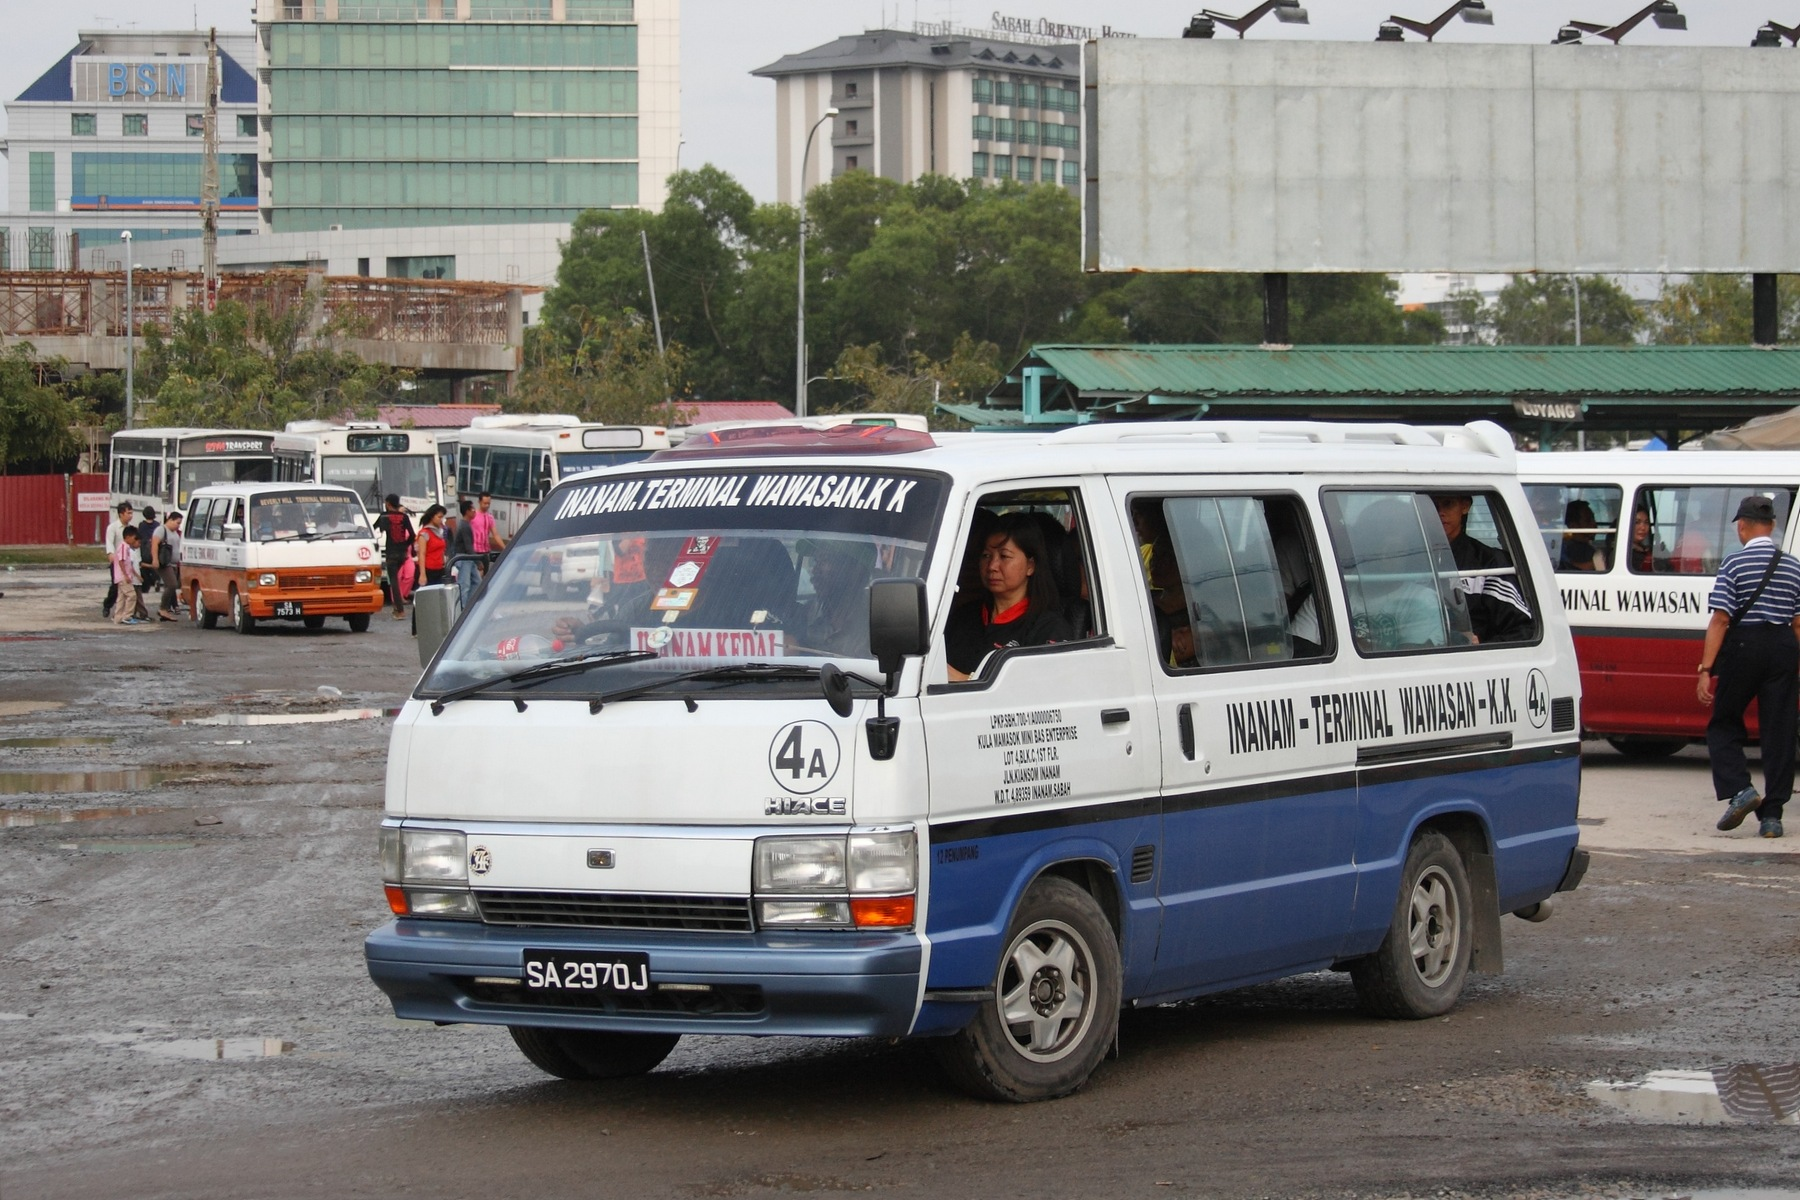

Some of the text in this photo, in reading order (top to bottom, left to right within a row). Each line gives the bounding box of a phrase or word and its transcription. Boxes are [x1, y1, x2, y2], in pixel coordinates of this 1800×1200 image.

[992, 11, 1031, 33] SABAH
[1038, 17, 1092, 40] ORIENTAL
[108, 63, 187, 97] BSN
[1522, 403, 1576, 419] LUYANG
[226, 441, 263, 451] TRANSPORT
[886, 480, 918, 513] K
[277, 608, 294, 616] 7573
[1617, 590, 1701, 614] WAWASAN
[1528, 674, 1547, 718] 4A
[977, 726, 1078, 749] KULA MAMASOK MINI BAS ENTERPRISE
[775, 725, 828, 780] 4A
[1003, 751, 1014, 765] LOT
[1039, 765, 1061, 781] INANAM
[764, 797, 846, 815] HIACE
